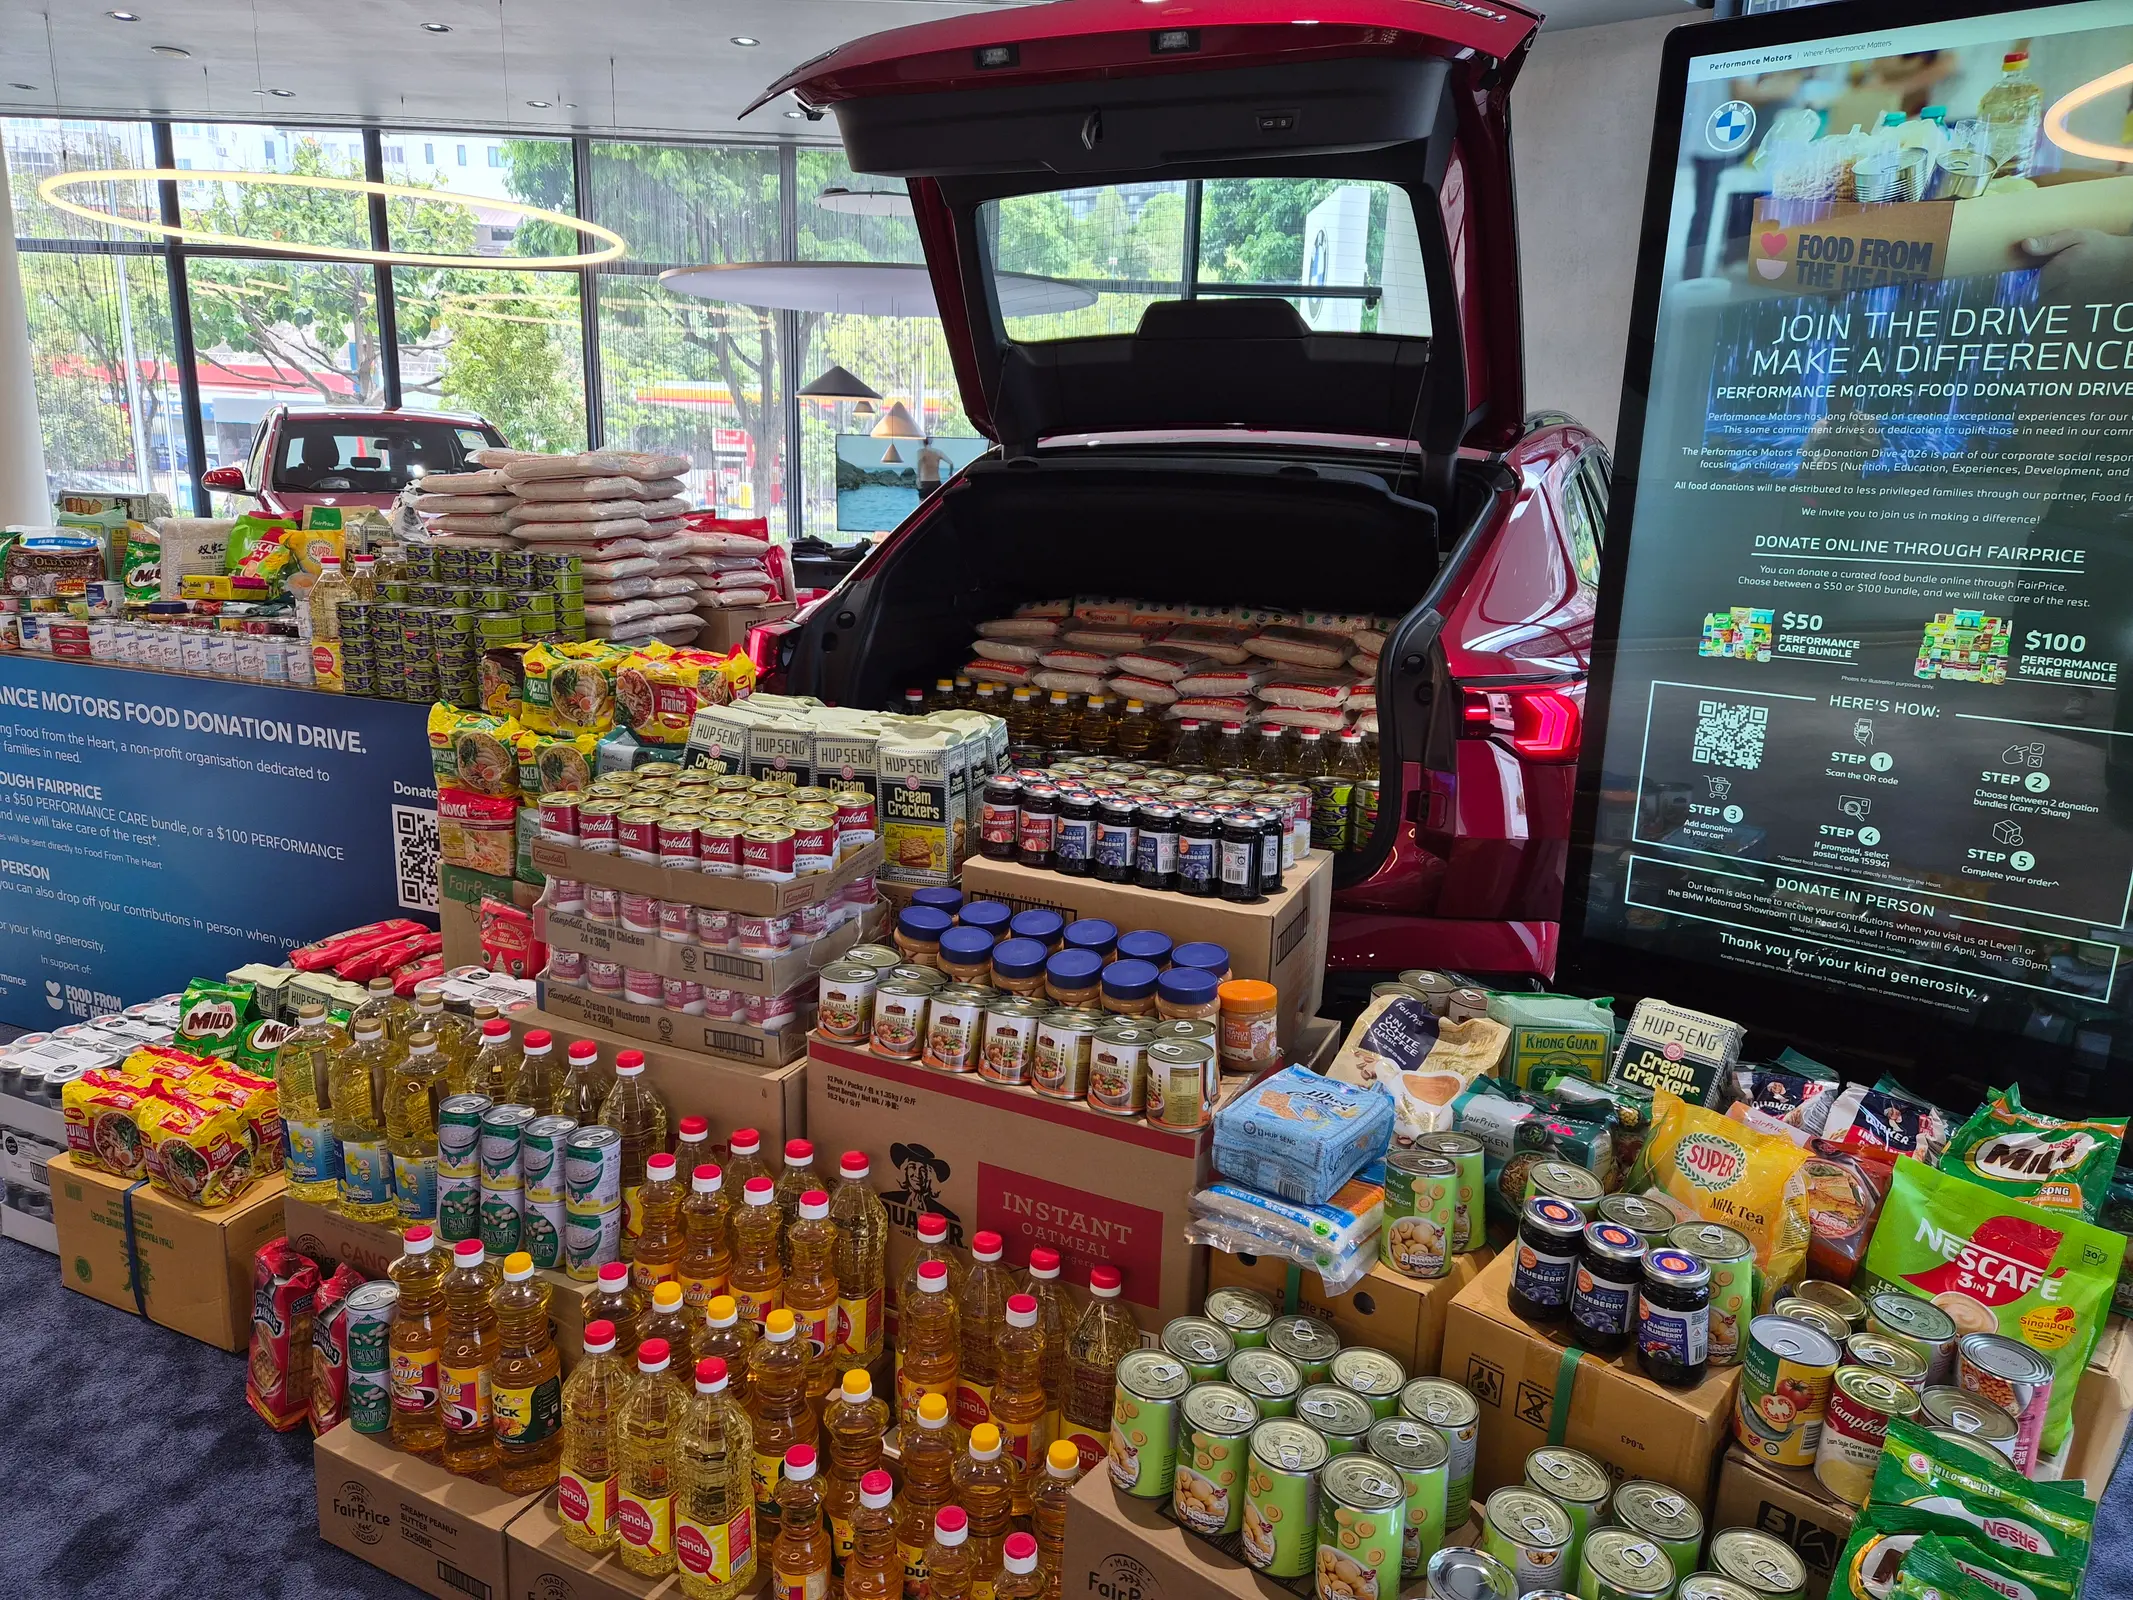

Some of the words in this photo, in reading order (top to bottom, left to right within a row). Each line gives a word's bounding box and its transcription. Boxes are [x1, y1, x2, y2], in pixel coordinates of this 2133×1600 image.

[1802, 50, 1824, 58] Where
[1824, 44, 1867, 55] Performance
[1867, 40, 1892, 49] Matters
[1709, 59, 1762, 71] Performance
[1762, 53, 1793, 63] Motors
[1796, 234, 1855, 263] FOOD
[1858, 238, 1934, 273] FROM
[1772, 313, 1851, 345] JOIN
[1864, 309, 1940, 339] THE
[1950, 305, 2072, 337] DRIVE
[1752, 347, 1851, 377] MAKE
[1858, 346, 1884, 373] A
[1716, 385, 1837, 399] PERFORMANCE
[1840, 383, 1914, 398] MOTORS
[1918, 383, 1969, 400] FOOD
[1973, 382, 2073, 397] DONATION
[1801, 507, 1817, 516] We
[1818, 508, 1846, 517] invite
[1847, 510, 1866, 519] you
[1868, 510, 1879, 518] to
[1880, 510, 1900, 520] join
[1903, 512, 1915, 520] us
[1918, 511, 1928, 520] in
[1930, 512, 1970, 523] making
[1982, 513, 2041, 524] difference!
[310, 546, 333, 558] SUPER
[1755, 535, 1821, 550] DONATE
[1825, 538, 1889, 554] ONLINE
[1893, 541, 1982, 558] THROUGH
[1987, 545, 2086, 564] FAIRPRICE
[1781, 611, 1823, 631] $50
[1777, 643, 1807, 654] CARE
[1807, 646, 1853, 658] BUNDLE
[1779, 634, 1861, 649] PERFORMANCE
[2024, 630, 2086, 653] $100
[2021, 654, 2118, 672] PERFORMANCE
[2018, 665, 2062, 678] SHARE
[2064, 669, 2117, 683] BUNDLE
[1829, 694, 1890, 712] HERE'S
[1894, 701, 1940, 718] HOW:
[41, 691, 121, 720] MOTORS
[124, 701, 180, 728] FOOD
[183, 709, 293, 744] DONATION
[297, 724, 367, 754] DRIVE.
[696, 723, 717, 744] HUP
[716, 727, 742, 748] SENG
[3, 742, 41, 757] families
[42, 747, 53, 759] in
[54, 751, 82, 764] need.
[14, 726, 40, 739] Food
[41, 730, 66, 743] from
[67, 733, 85, 746] the
[87, 735, 118, 753] Heart,
[120, 742, 127, 752] a
[130, 743, 183, 761] non-profit
[185, 752, 254, 771] organisation
[256, 759, 314, 780] dedicated
[316, 768, 330, 782] to
[755, 736, 778, 754] HUP
[777, 738, 806, 757] SENG
[821, 747, 844, 765] HUP
[844, 748, 874, 766] SENG
[695, 753, 729, 775] Cream
[885, 756, 910, 774] HUP
[910, 757, 940, 776] SENG
[1831, 751, 1867, 765] STEP
[1878, 757, 1886, 769] 1
[762, 767, 799, 787] Cream
[1825, 768, 1846, 778] Scan
[1847, 771, 1862, 780] the
[1862, 773, 1877, 782] QR
[1878, 777, 1899, 785] code
[1981, 771, 2021, 785] STEP
[2030, 775, 2044, 790] 2
[37, 781, 103, 801] FAIRPRICE
[393, 780, 440, 802] Donate
[894, 787, 933, 806] Cream
[440, 802, 469, 818] KOKA
[887, 800, 941, 821] Crackers
[1688, 803, 1720, 816] STEP
[1729, 809, 1739, 821] 3
[1819, 824, 1855, 838] STEP
[1864, 831, 1875, 843] 4
[1967, 848, 2006, 863] STEP
[2017, 855, 2028, 869] 5
[1, 858, 50, 881] PERSON
[1775, 877, 1840, 900] DONATE
[1844, 890, 1861, 903] IN
[1865, 893, 1935, 917] PERSON
[580, 933, 588, 943] 24
[594, 936, 610, 951] 300g
[586, 922, 607, 937] Cream
[608, 928, 616, 940] Of
[616, 930, 645, 946] Chicken
[40, 955, 49, 964] In
[49, 958, 80, 972] support
[1719, 932, 1763, 952] Thank
[1765, 943, 1791, 958] you
[1794, 948, 1816, 963] for
[1817, 953, 1851, 972] your
[1854, 961, 1887, 979] kind
[1890, 970, 1978, 1000] generosity.
[65, 984, 93, 1005] FOOD
[93, 990, 123, 1012] FROM
[188, 1011, 235, 1031] MILO
[1373, 1027, 1399, 1049] CLASSIC
[1378, 1021, 1420, 1059] COFFEE
[1385, 1017, 1422, 1051] WHITE
[1526, 1034, 1566, 1051] KHONG
[1567, 1035, 1599, 1052] GUAN
[1642, 1015, 1676, 1038] HUP
[1675, 1025, 1719, 1052] SENG
[1639, 1051, 1696, 1083] Cream
[1623, 1063, 1702, 1098] Crackers
[1464, 1113, 1501, 1130] FairPrice
[1687, 1144, 1738, 1178] SUPER
[1002, 1191, 1134, 1246] INSTANT
[1709, 1196, 1737, 1217] Milk
[1738, 1206, 1766, 1226] Tea
[1021, 1222, 1112, 1261] OATMEAL
[1914, 1217, 2070, 1302] NESCAFÉ
[2084, 1249, 2099, 1261] 30
[1518, 1266, 1568, 1283] BLUEBERRY
[1540, 1268, 1568, 1278] TASTY
[1575, 1288, 1626, 1311] BLUEBERRY
[1595, 1293, 1626, 1305] TASTY
[2019, 1316, 2078, 1335] Singapore
[1933, 1464, 1959, 1483] MILO
[346, 1484, 366, 1496] MADE
[559, 1484, 589, 1510] canola
[333, 1498, 391, 1527] FairPrice
[400, 1503, 429, 1522] CREAMY
[429, 1516, 459, 1538] PEANUT
[400, 1513, 429, 1533] BUTTER
[618, 1509, 651, 1531] canola
[356, 1530, 377, 1543] GOOD
[1982, 1518, 2040, 1554] Nestlé
[677, 1536, 711, 1559] canola
